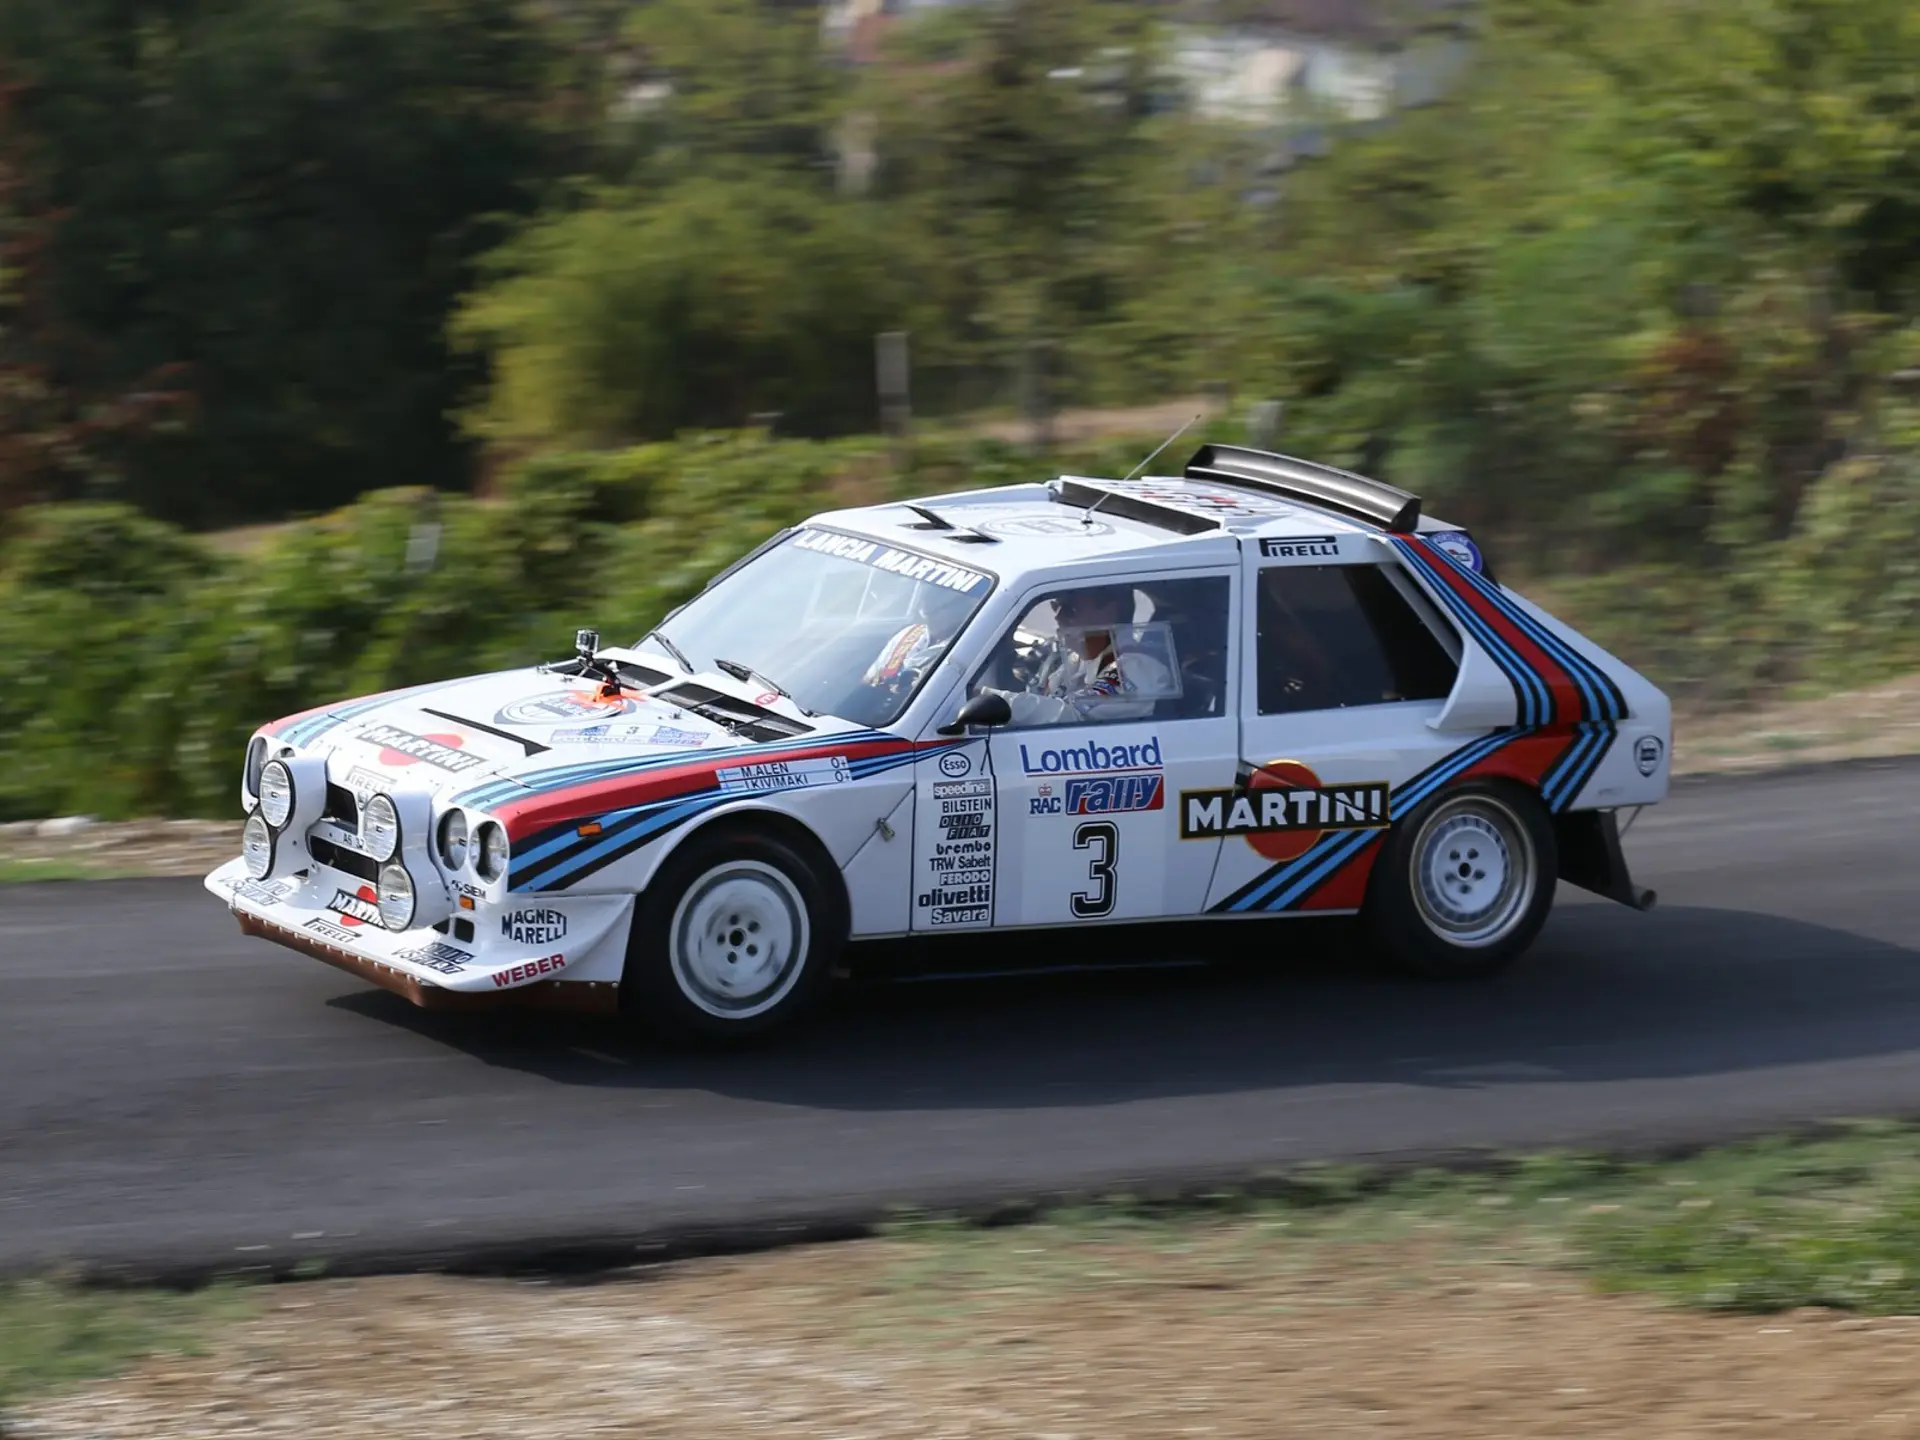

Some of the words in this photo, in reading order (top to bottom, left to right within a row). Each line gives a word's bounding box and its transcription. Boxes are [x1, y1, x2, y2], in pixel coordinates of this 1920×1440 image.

[1258, 536, 1340, 557] PIRELLI
[794, 529, 874, 562] LANCIA
[872, 548, 983, 593] MARTINI
[361, 726, 481, 771] MARTINI
[1020, 737, 1163, 773] Lombard
[944, 759, 966, 770] Esso
[942, 798, 991, 813] BILSTEIN
[1029, 797, 1061, 814] RAC
[1067, 776, 1163, 814] rally
[940, 814, 982, 827] OLIO
[1189, 790, 1381, 832] MARTINI
[948, 827, 989, 839] FIAT
[936, 841, 991, 855] brembo
[929, 857, 955, 871] TRW
[958, 856, 991, 869] Sabelt
[1070, 820, 1119, 919] 3
[940, 871, 990, 885] FERODO
[918, 885, 990, 907] olivetti
[931, 907, 989, 924] Savara
[303, 917, 362, 943] PIRELLI
[492, 953, 566, 987] WEBER
